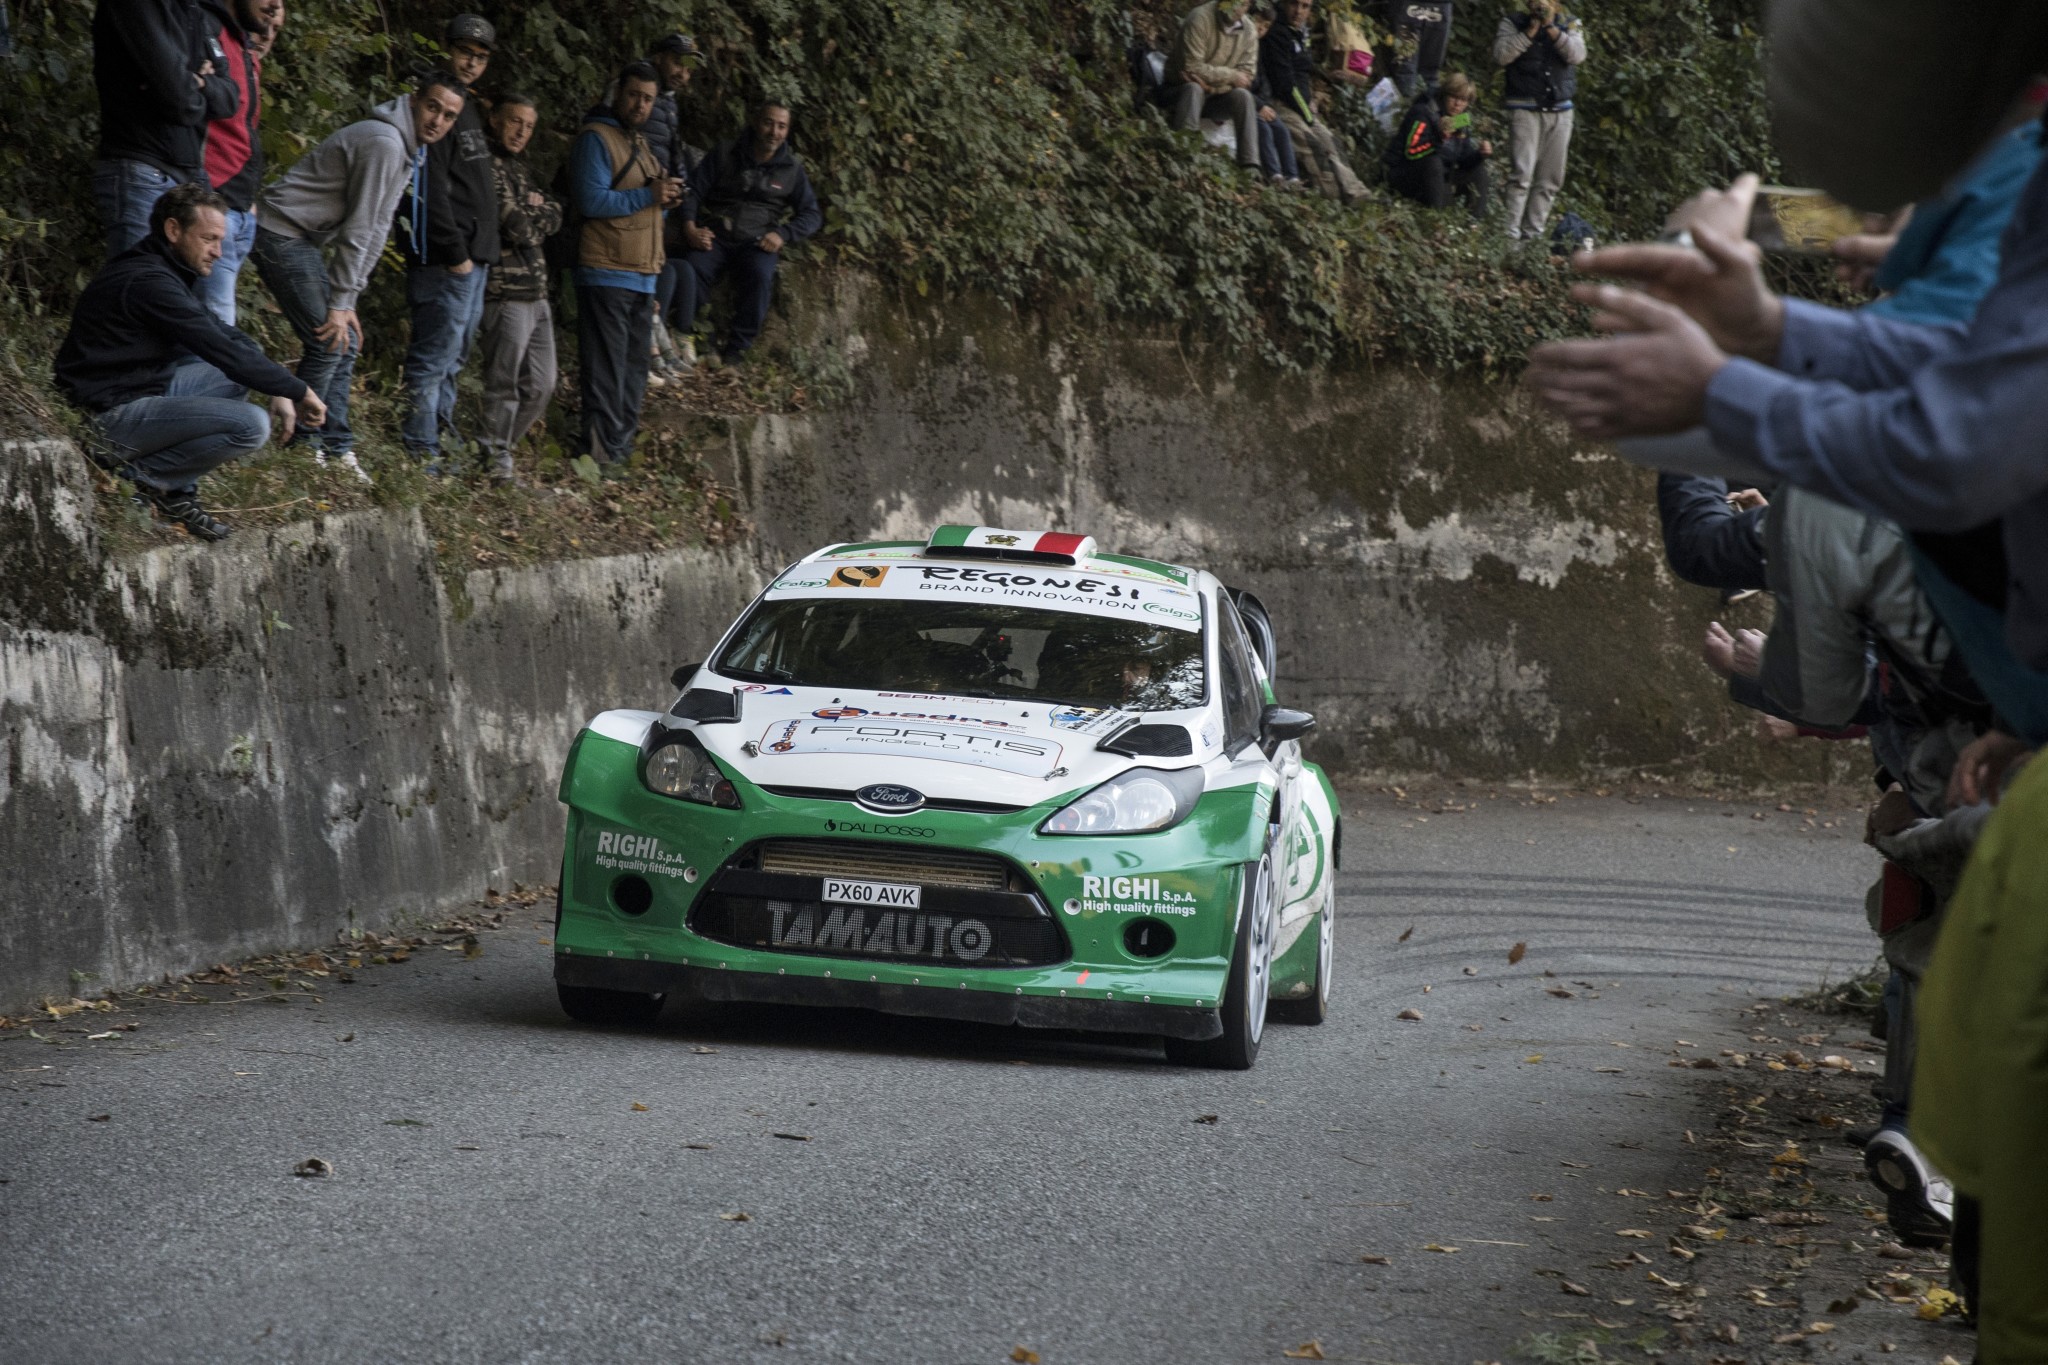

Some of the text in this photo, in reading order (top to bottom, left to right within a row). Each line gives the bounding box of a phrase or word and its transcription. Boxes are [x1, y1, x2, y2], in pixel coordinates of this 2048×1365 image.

[897, 566, 1139, 600] REGONESI
[919, 583, 1136, 610] BRAND INNOVATION
[1149, 604, 1194, 618] Falga
[811, 726, 1047, 756] FORTIS
[846, 737, 960, 750] ANGELO
[871, 786, 909, 803] Ford
[597, 831, 686, 864] RIGHI S.p.A.
[596, 854, 684, 878] High quality fittings
[828, 882, 920, 905] PX60 AVK
[1083, 875, 1197, 903] RIGHI S.p.A.
[1083, 900, 1196, 917] High quality fittings
